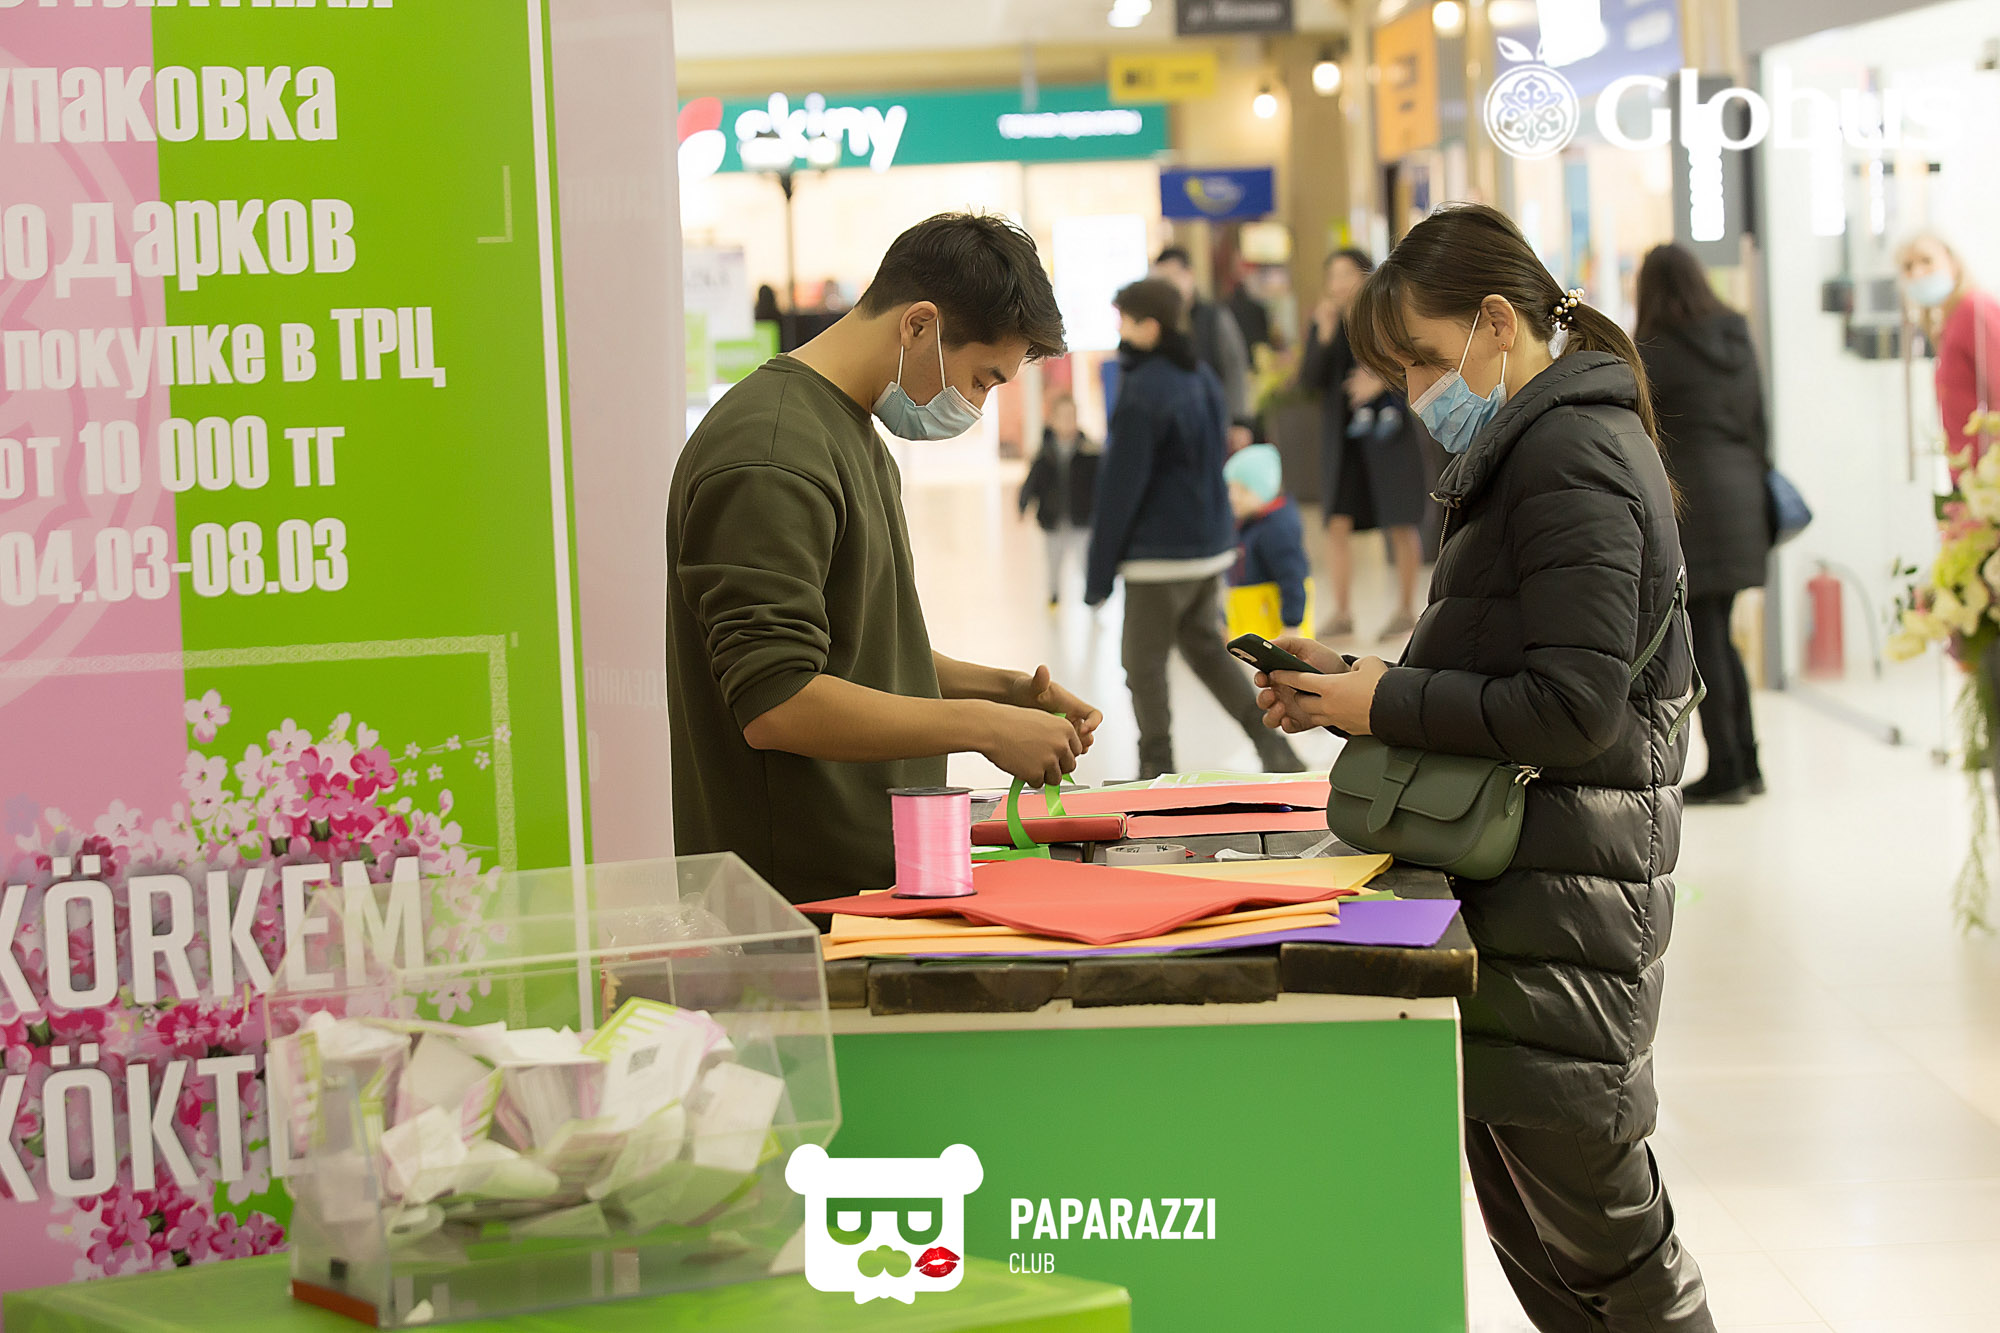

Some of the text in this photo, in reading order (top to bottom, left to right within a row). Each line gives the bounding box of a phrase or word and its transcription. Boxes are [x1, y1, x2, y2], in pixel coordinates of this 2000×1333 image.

[0, 198, 357, 298] одарков
[4, 306, 447, 399] покупке в ТРЦ
[0, 415, 346, 500] от 10 000 тг
[0, 517, 349, 606] 04.03-08.03
